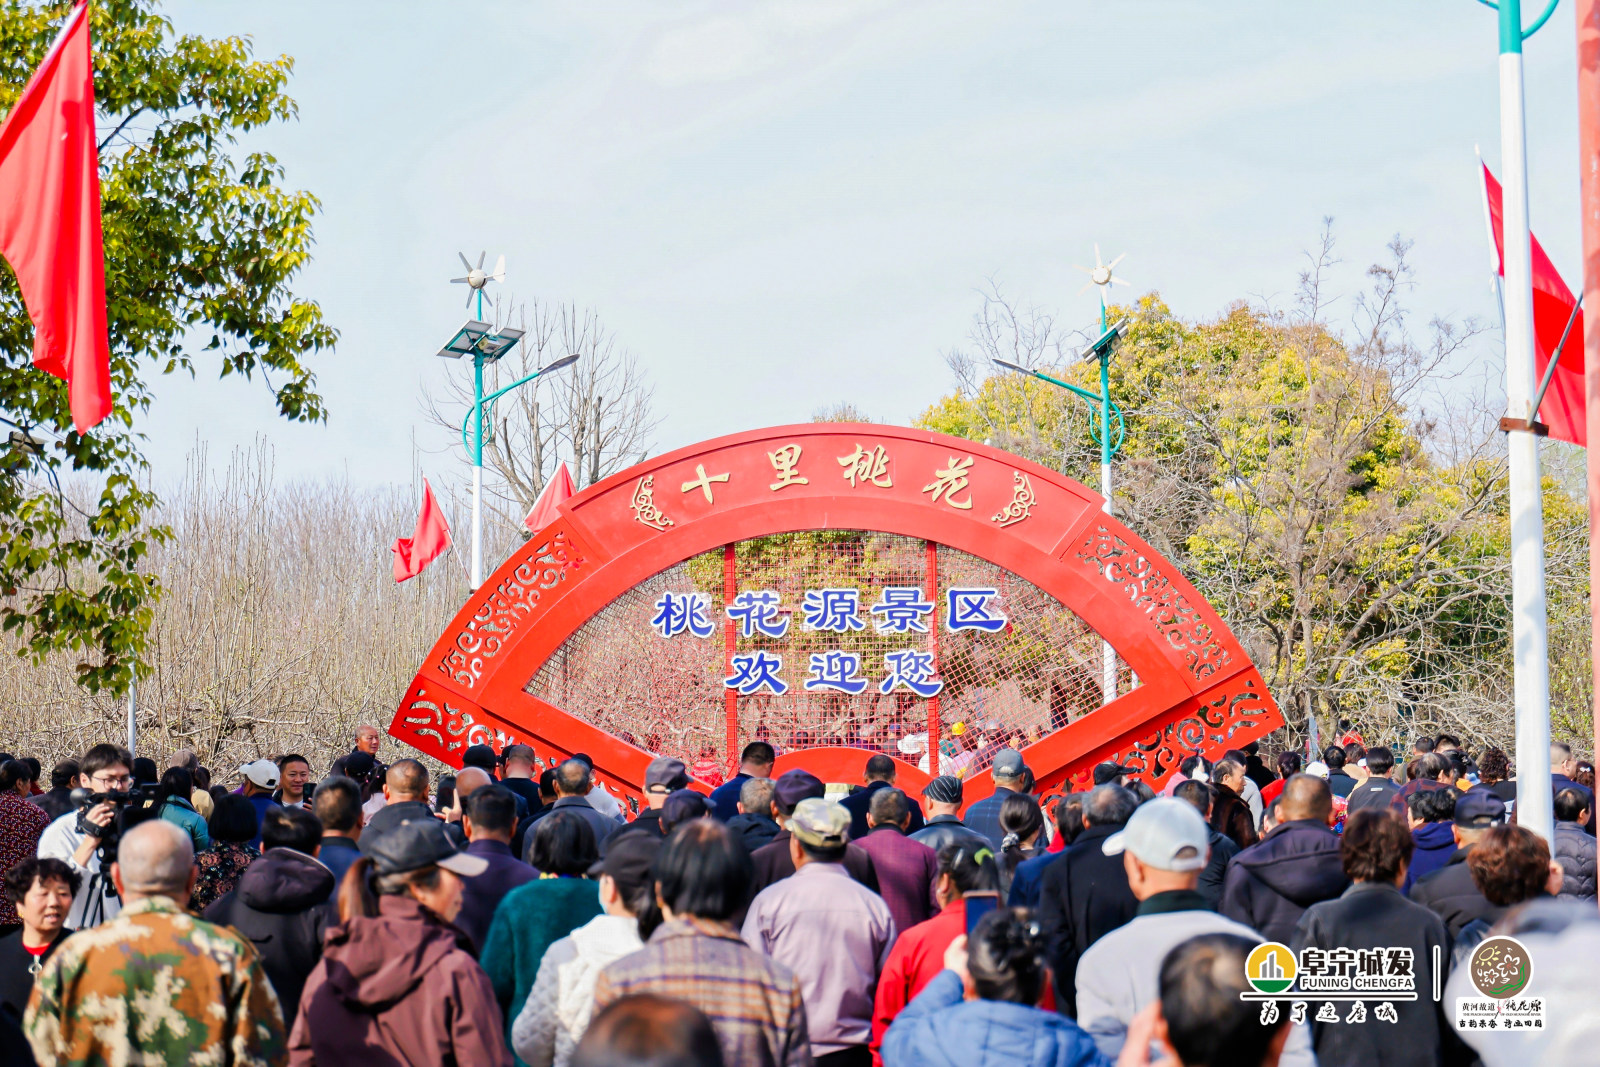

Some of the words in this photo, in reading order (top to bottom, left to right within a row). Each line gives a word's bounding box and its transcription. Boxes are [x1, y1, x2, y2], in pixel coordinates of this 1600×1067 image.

[680, 442, 974, 510] 十里桃花
[650, 587, 1009, 639] 桃花源景区
[723, 650, 945, 698] 欢迎您
